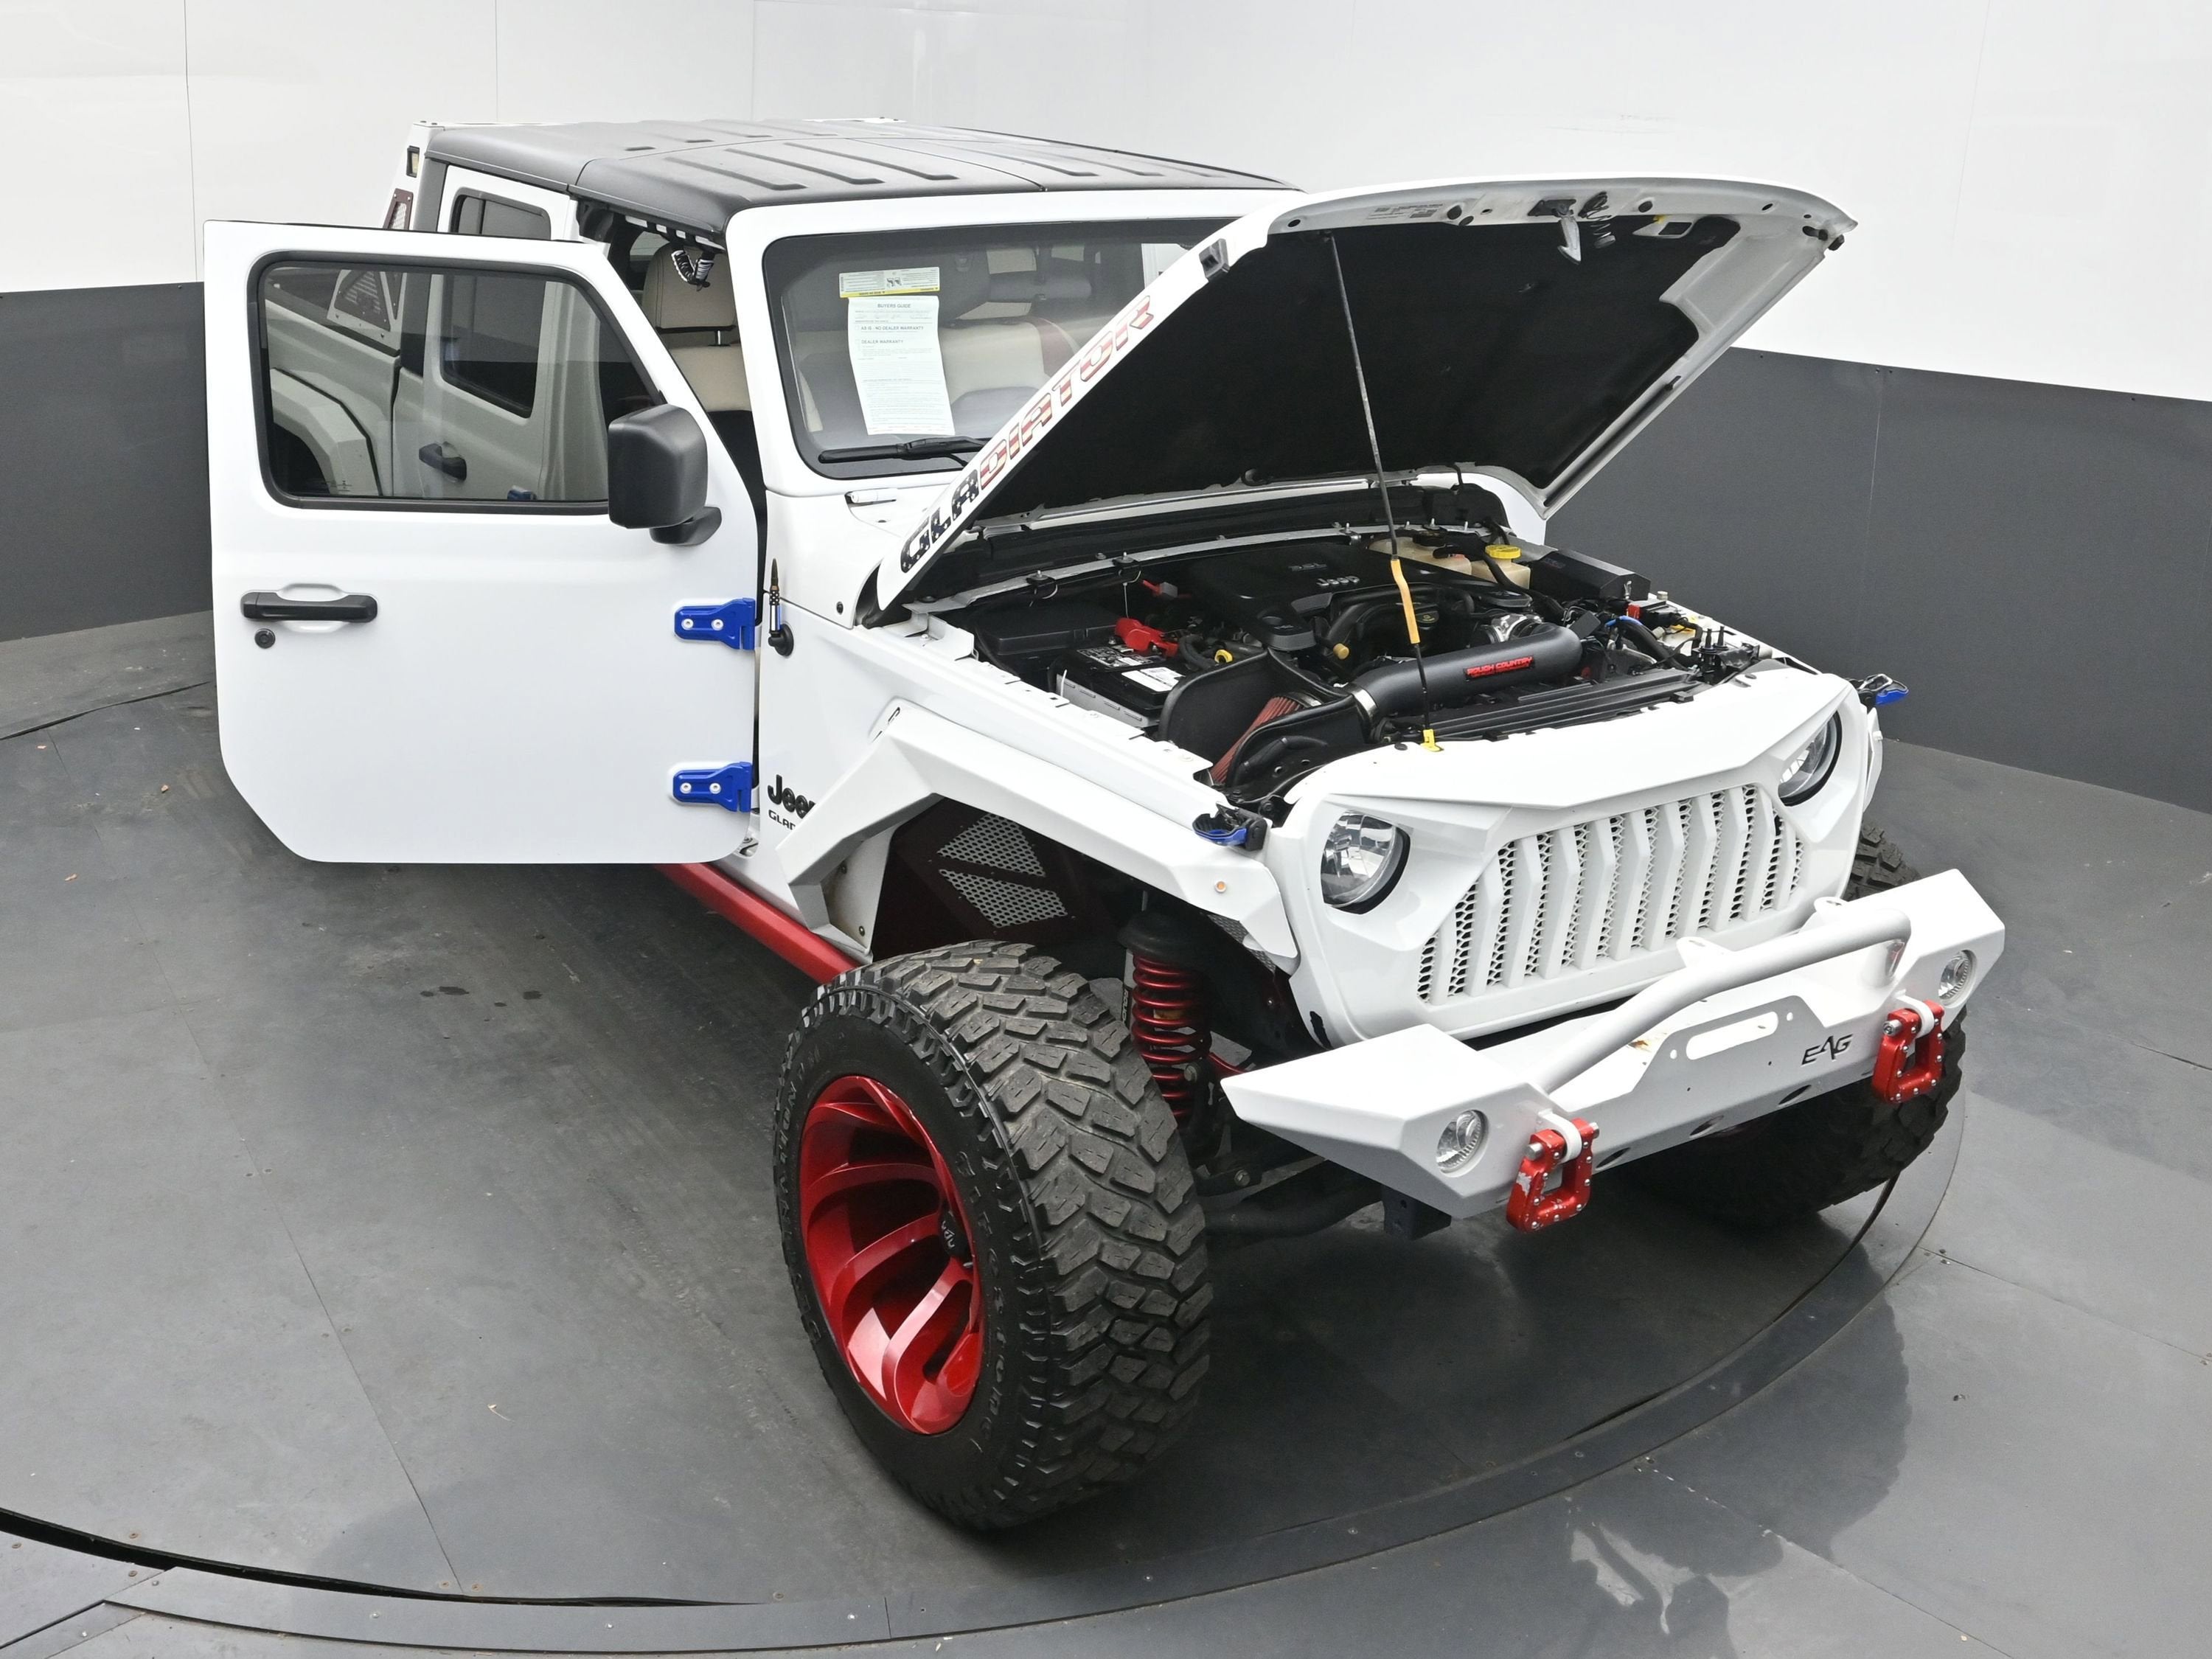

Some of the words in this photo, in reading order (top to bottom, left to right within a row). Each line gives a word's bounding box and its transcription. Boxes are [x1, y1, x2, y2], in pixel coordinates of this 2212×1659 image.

[900, 295, 1154, 574] GLADIATOR
[768, 774, 816, 819] Jee
[1801, 1034, 1854, 1065] EAG
